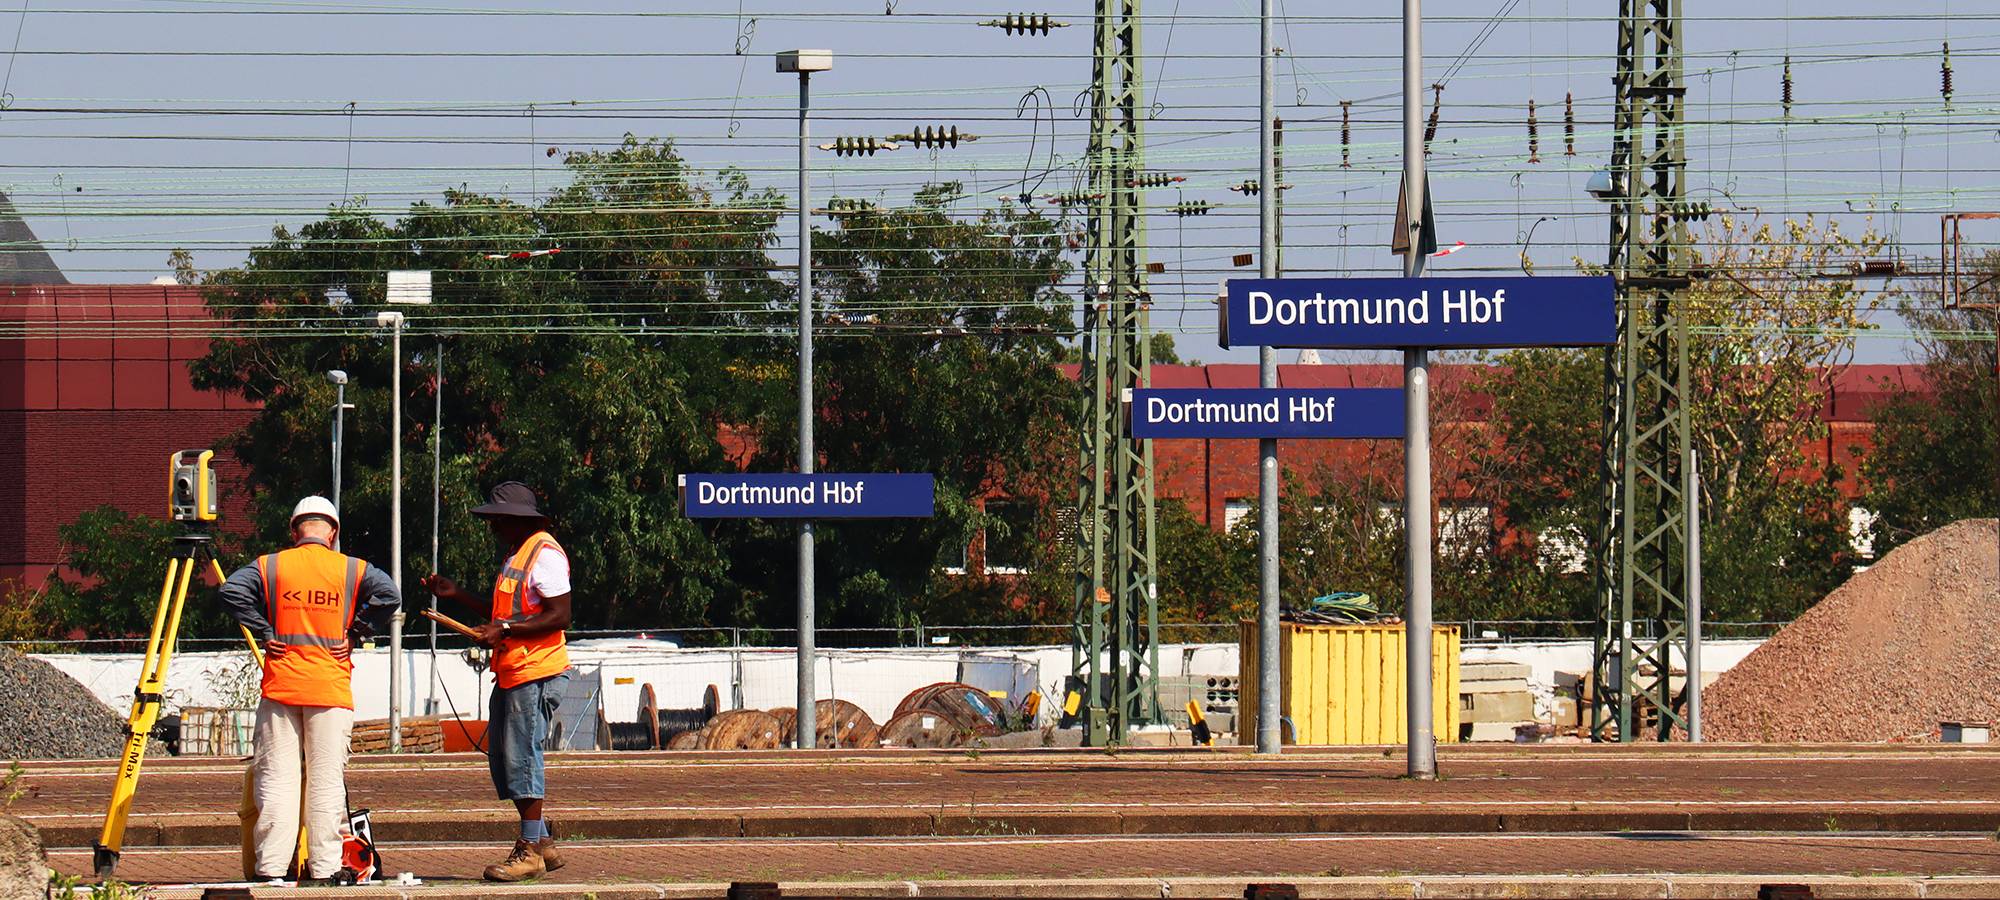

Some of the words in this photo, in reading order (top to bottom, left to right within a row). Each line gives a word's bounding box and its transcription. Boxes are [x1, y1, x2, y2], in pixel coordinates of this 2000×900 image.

[1248, 290, 1429, 325] Dortmund
[1442, 289, 1505, 324] Hbf
[1147, 397, 1280, 423] Dortmund
[1289, 396, 1335, 423] Hbf
[698, 481, 815, 505] Dortmund
[823, 481, 864, 504] Hbf
[308, 590, 339, 606] IBH
[125, 732, 144, 779] Tri-Max
